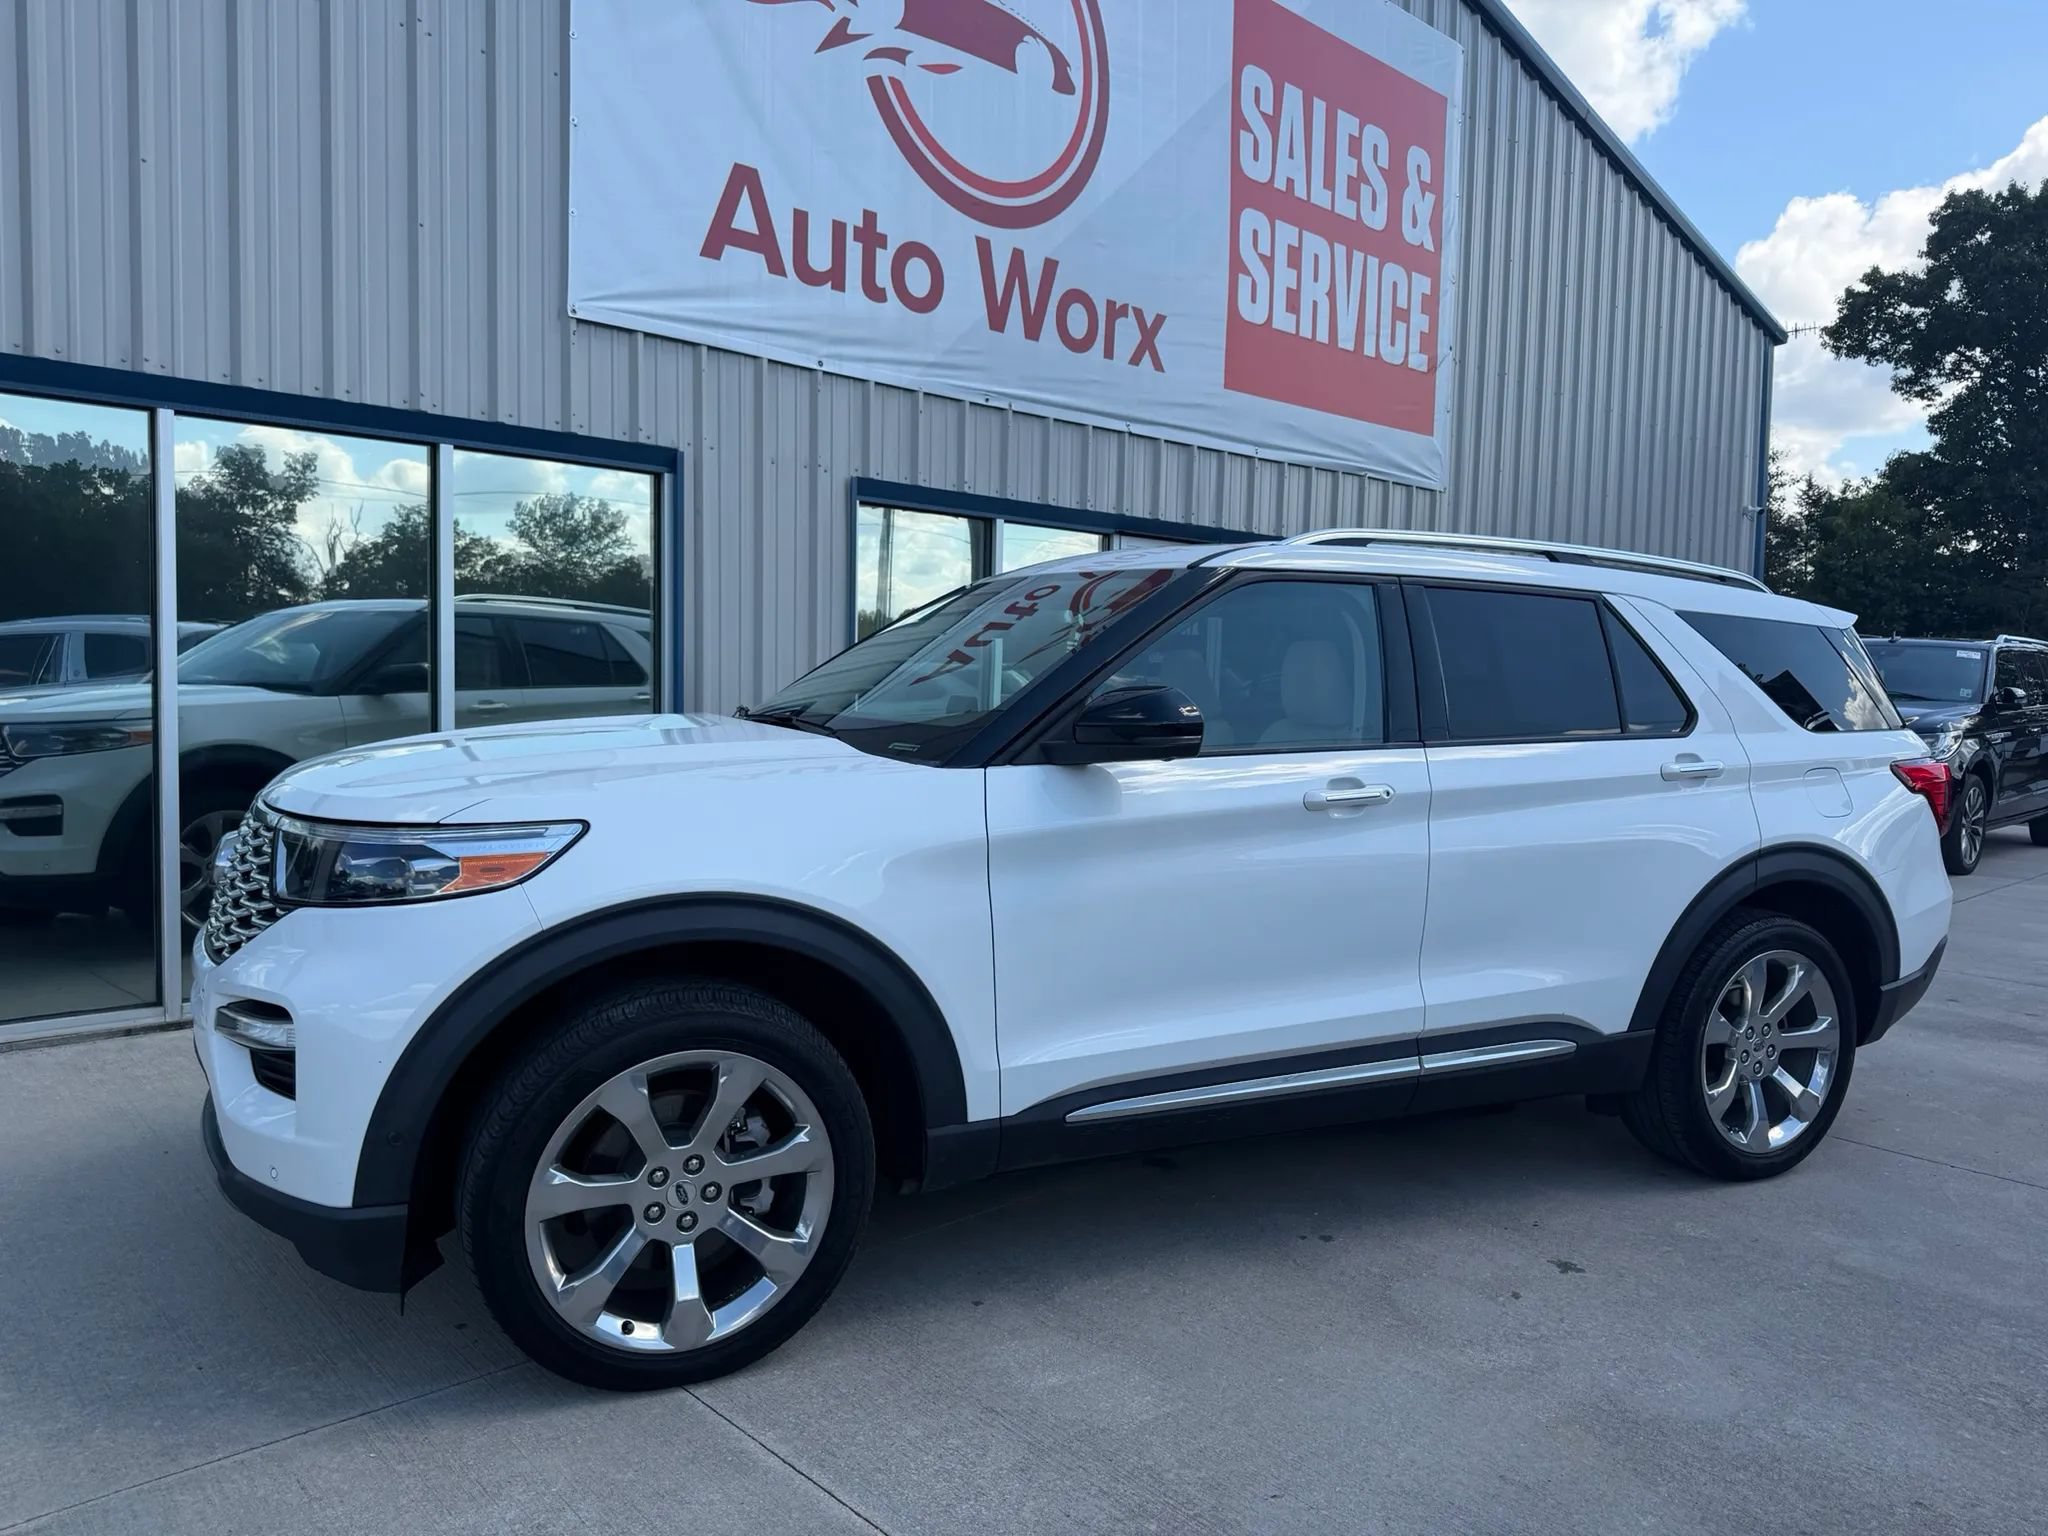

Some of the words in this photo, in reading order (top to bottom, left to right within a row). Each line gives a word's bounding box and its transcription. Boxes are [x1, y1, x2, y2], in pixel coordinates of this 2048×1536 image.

[1240, 64, 1389, 231] SALES
[1402, 145, 1436, 252] &
[700, 162, 944, 314] Auto
[975, 235, 1167, 373] Worx
[1238, 207, 1432, 373] SERVICE
